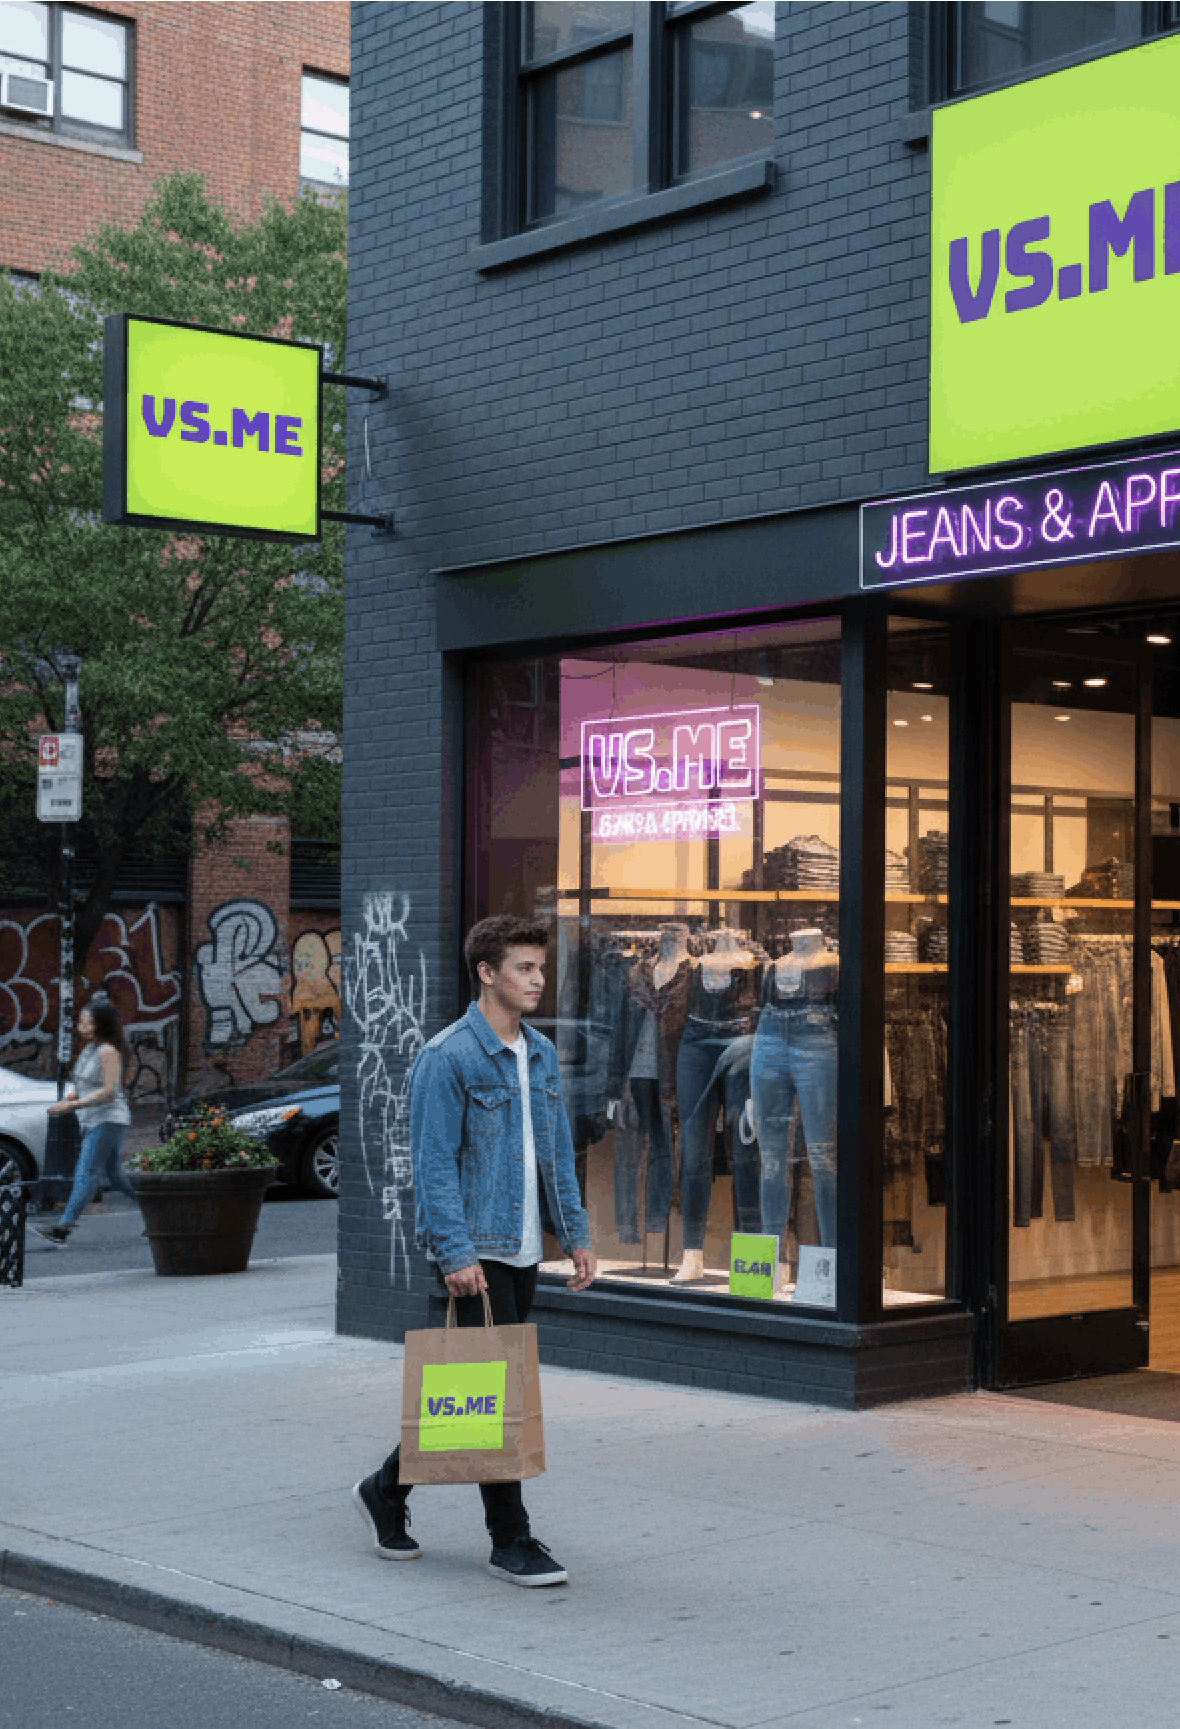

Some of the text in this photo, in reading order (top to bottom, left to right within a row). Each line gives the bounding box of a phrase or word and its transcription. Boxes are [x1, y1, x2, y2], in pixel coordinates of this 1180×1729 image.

[142, 394, 304, 458] VS.ME
[875, 496, 1024, 567] JEANS
[1041, 488, 1075, 542] &
[588, 718, 753, 798] VS.ME
[427, 1394, 498, 1417] VS.ME
